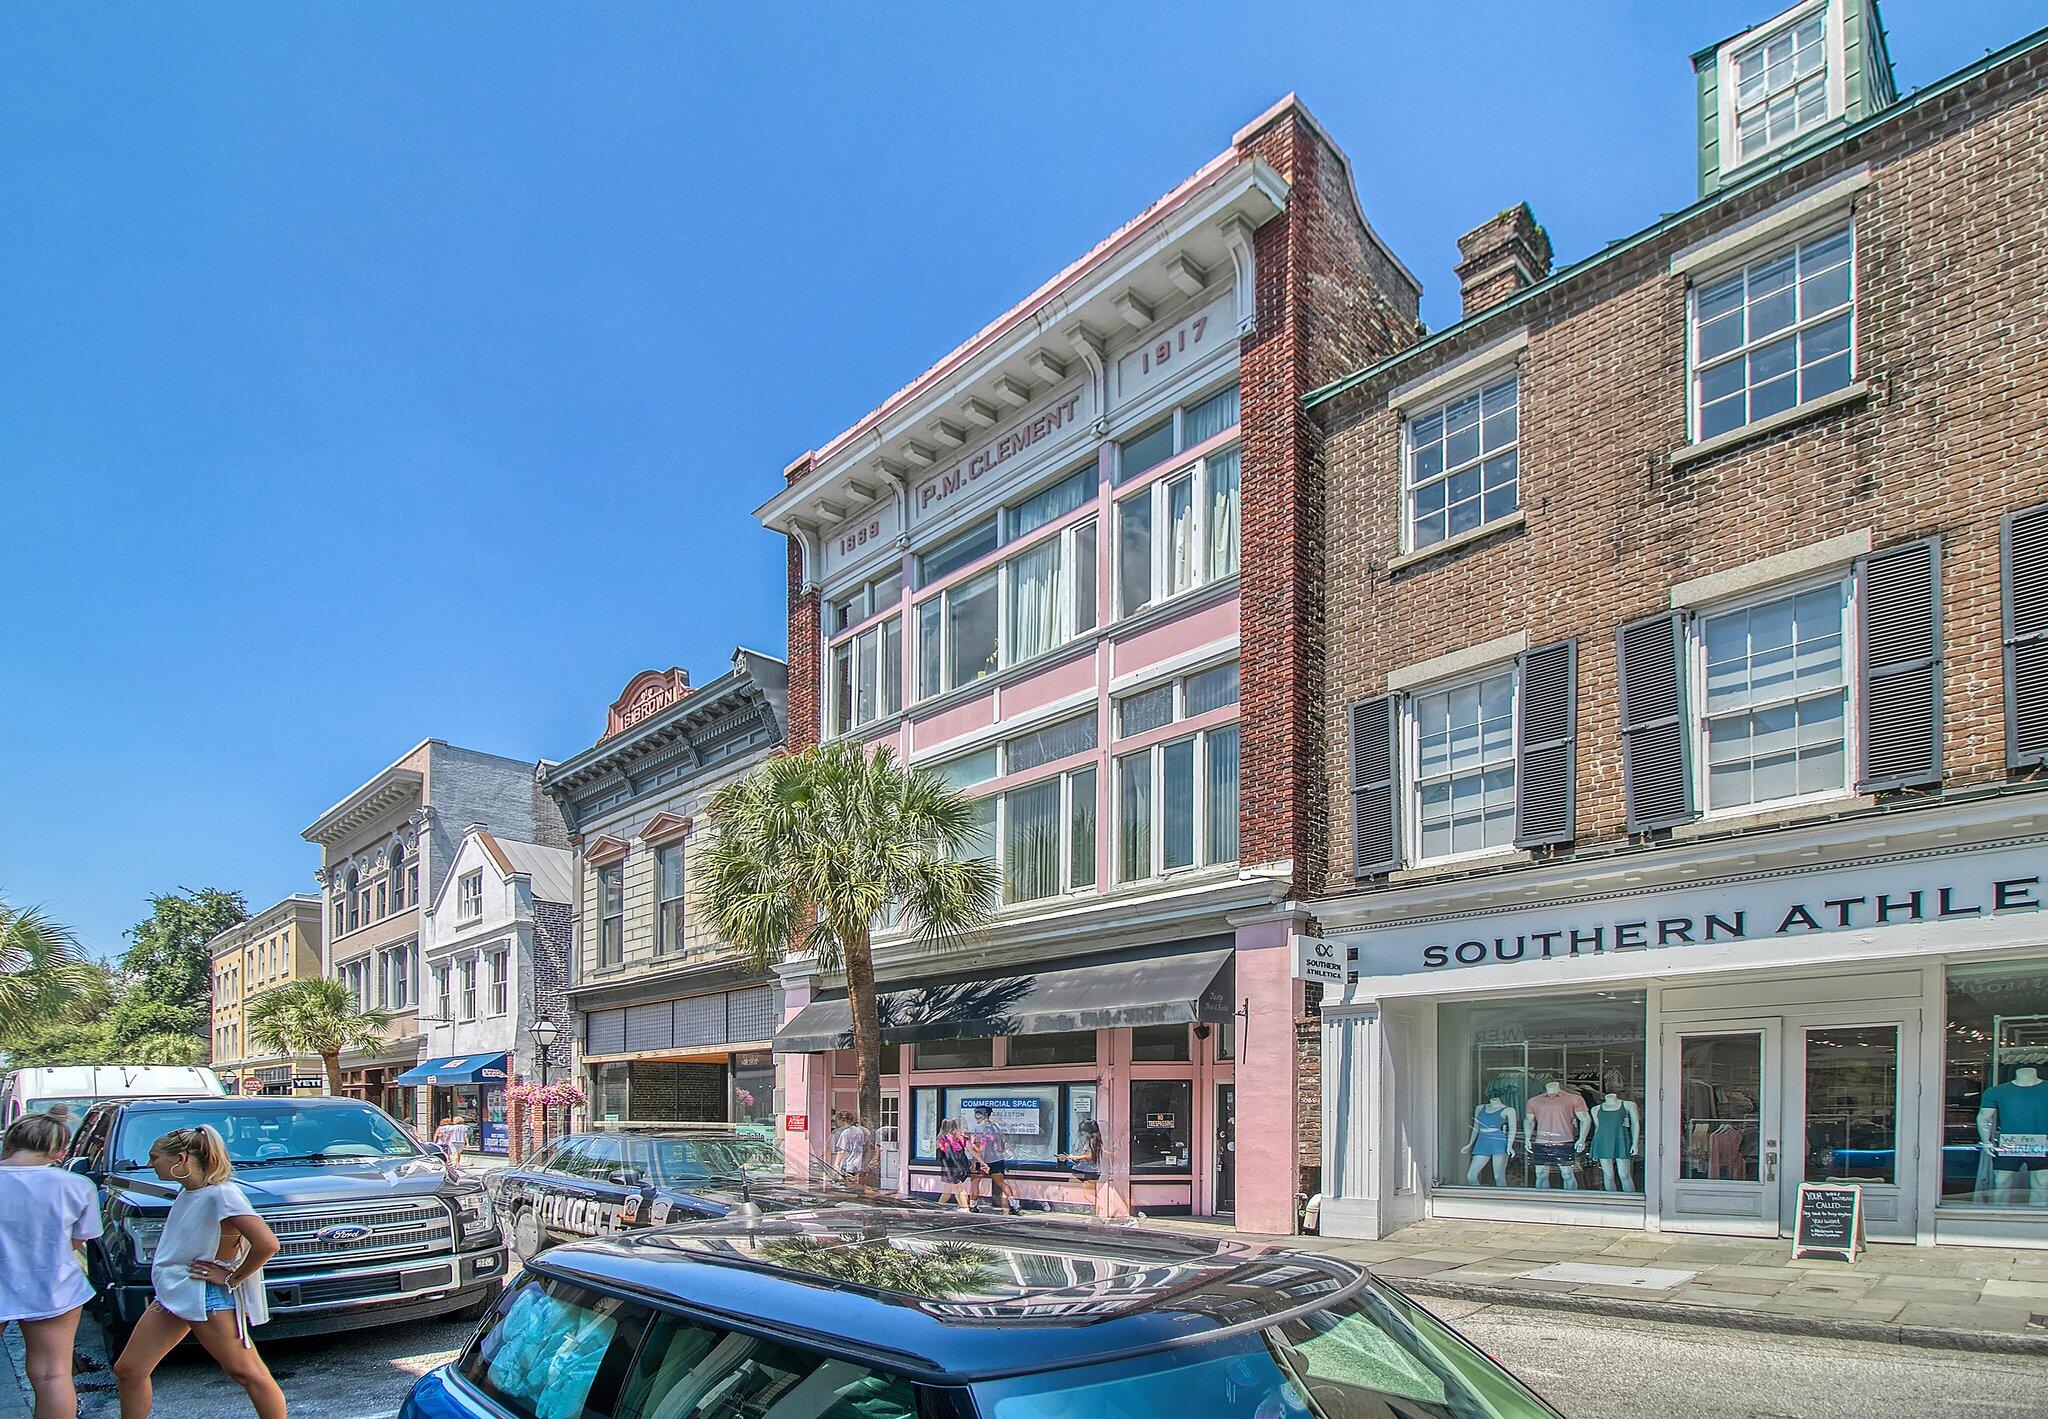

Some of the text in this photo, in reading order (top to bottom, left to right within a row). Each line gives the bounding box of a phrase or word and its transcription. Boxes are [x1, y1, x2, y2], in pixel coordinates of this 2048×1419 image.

[1141, 316, 1208, 374] 1917
[840, 521, 879, 556] 1889
[1422, 875, 2041, 968] SOUTHERN ATHLE
[1306, 959, 1342, 971] SOUTHERN
[1306, 968, 1342, 979] ATHLETICA
[294, 1079, 322, 1087] YETI
[962, 1100, 1038, 1108] COMMERCIAL SPACE
[1805, 1192, 1823, 1200] YOUR
[332, 1229, 361, 1239] Ford
